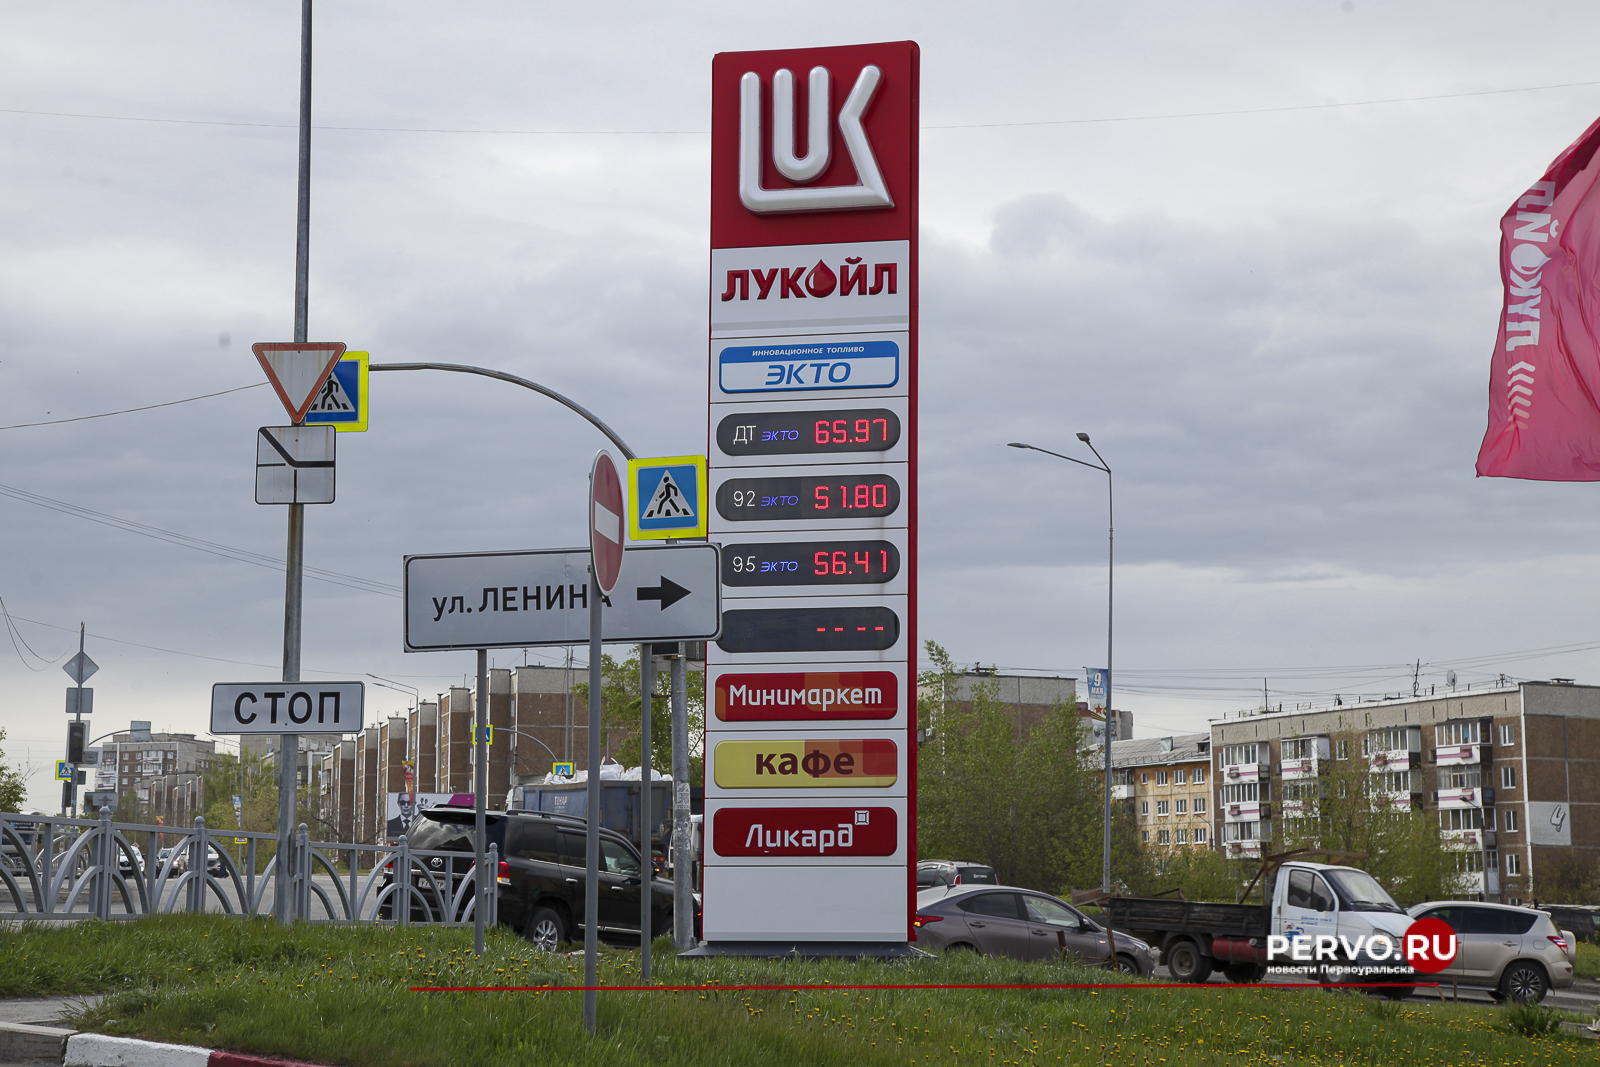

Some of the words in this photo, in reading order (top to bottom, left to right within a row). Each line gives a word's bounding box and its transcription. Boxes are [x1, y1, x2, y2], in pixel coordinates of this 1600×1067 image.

[721, 256, 897, 301] ЛУКОЙЛ
[752, 347, 823, 357] ИННОВАЦИОННОЕ
[826, 346, 865, 354] ТОПЛИВО
[765, 362, 851, 385] ЭКТО
[733, 425, 756, 445] ДТ
[761, 430, 799, 441] ЭКТО
[814, 418, 888, 444] 65.97
[733, 490, 755, 507] 92
[761, 495, 799, 507] ЭКТО
[814, 484, 888, 510] 51.80
[732, 556, 756, 573] 95
[760, 561, 799, 572] ЭКТО
[814, 550, 888, 575] 56.41
[432, 596, 473, 621] ул.
[1093, 672, 1102, 686] 9
[234, 692, 341, 725] СТОП
[729, 684, 882, 711] Минимаркет
[755, 750, 855, 778] кафе
[745, 823, 853, 853] Ликард
